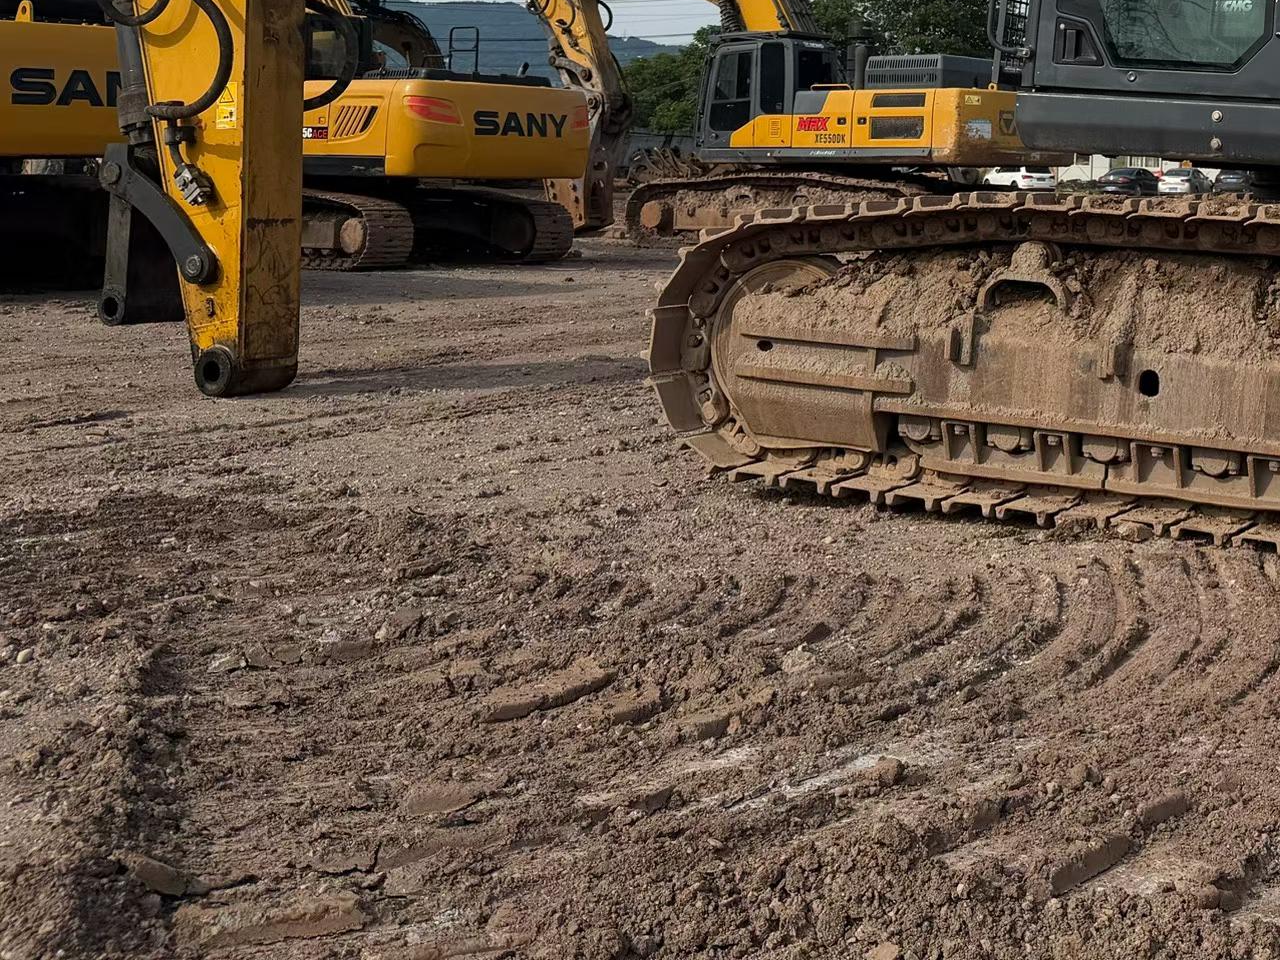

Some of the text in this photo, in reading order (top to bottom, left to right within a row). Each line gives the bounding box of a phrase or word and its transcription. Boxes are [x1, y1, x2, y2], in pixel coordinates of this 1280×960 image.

[473, 110, 568, 138] SANY
[797, 116, 831, 132] MAX
[814, 133, 846, 144] XE550DK
